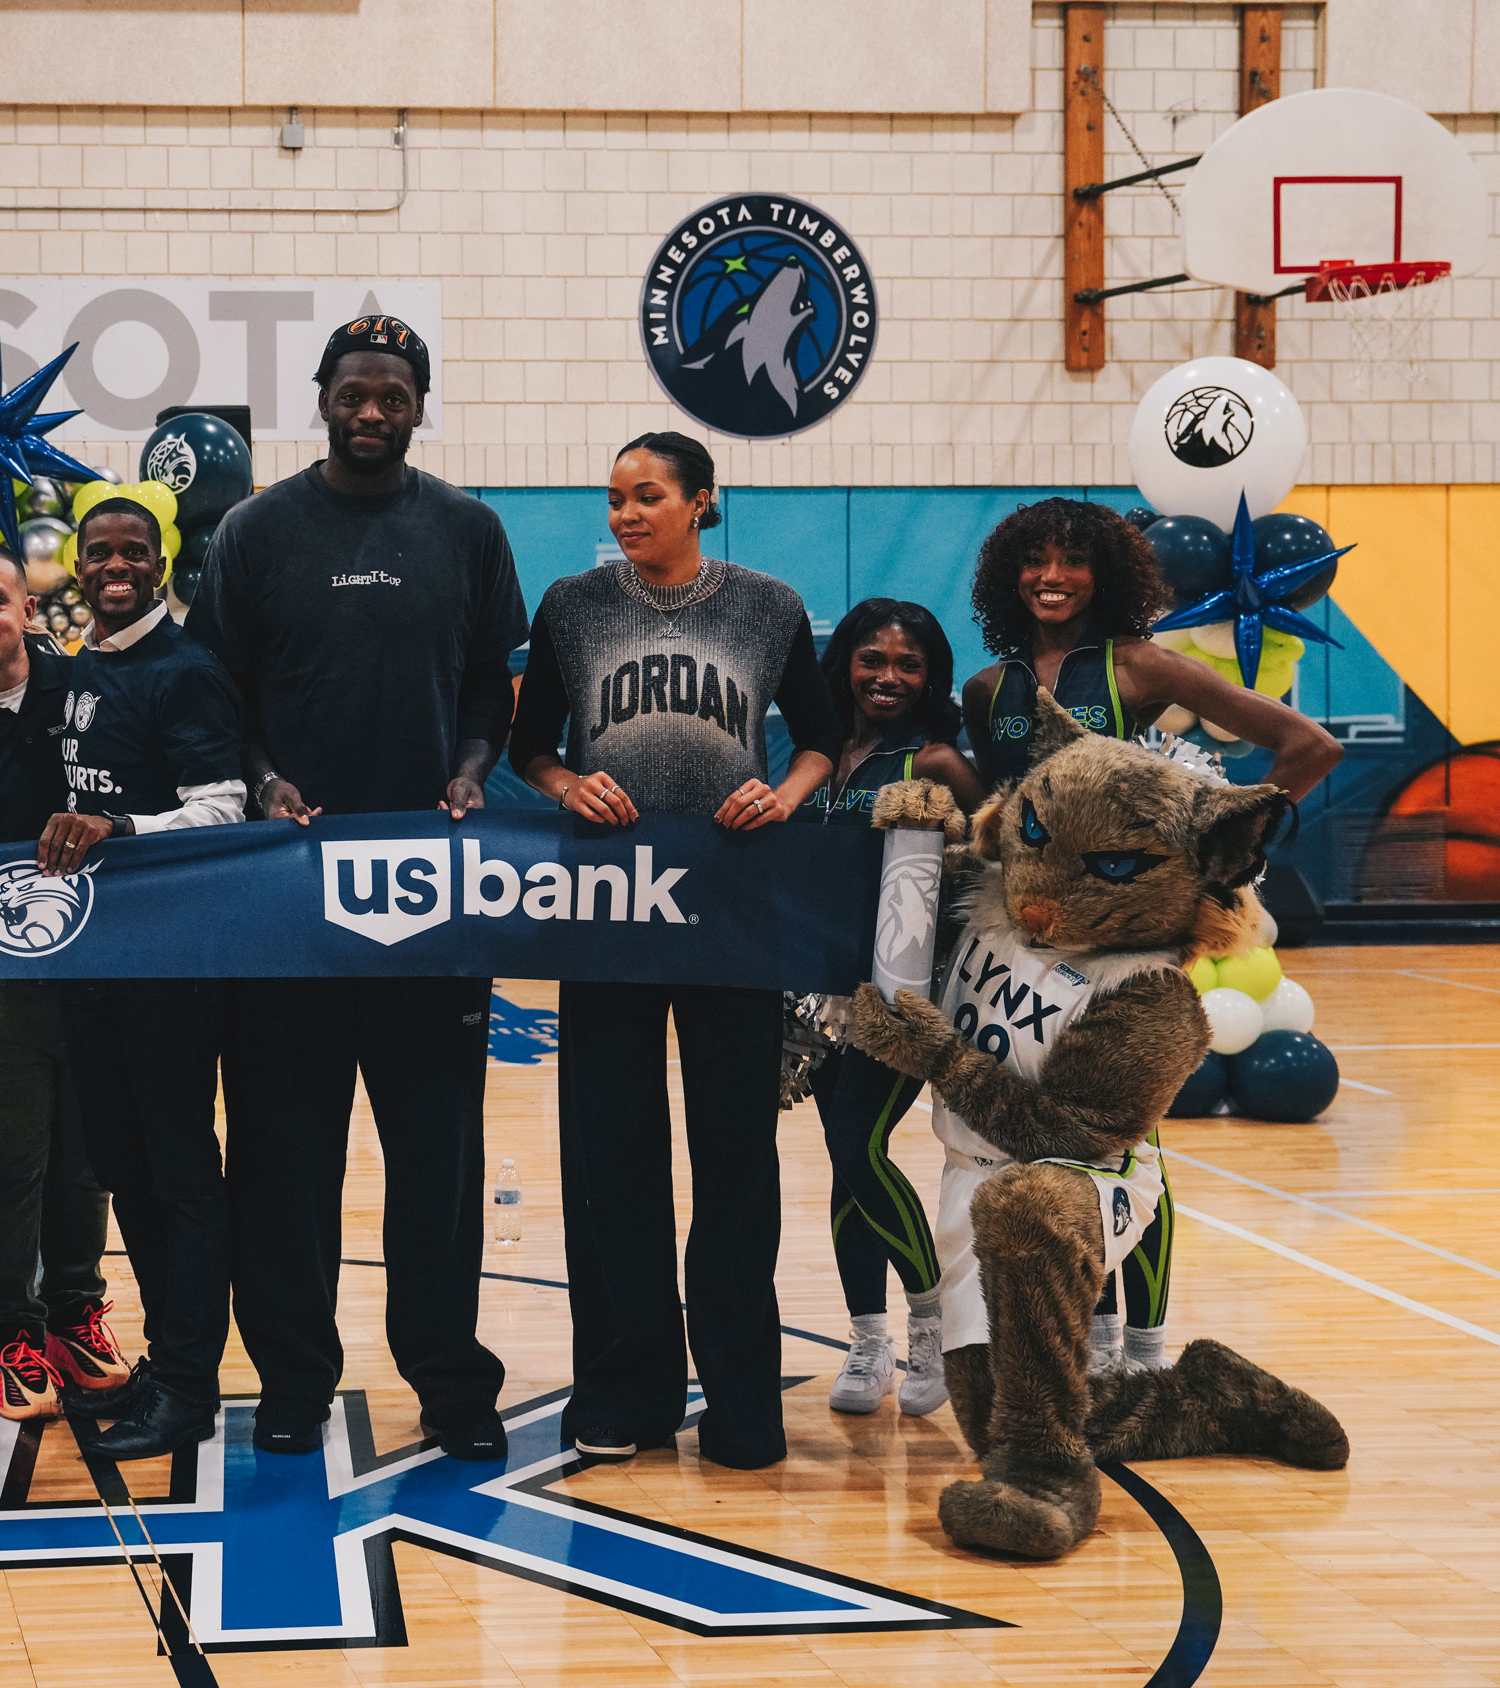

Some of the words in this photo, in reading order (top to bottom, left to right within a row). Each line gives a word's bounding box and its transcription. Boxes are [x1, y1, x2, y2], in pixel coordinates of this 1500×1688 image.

[650, 204, 753, 346] MINNESOTA
[770, 203, 870, 400] TIMBERWOLVES
[589, 653, 748, 751] JORDAN
[64, 764, 123, 794] URTS.
[336, 857, 439, 916] us
[959, 937, 1063, 1045] LYNX
